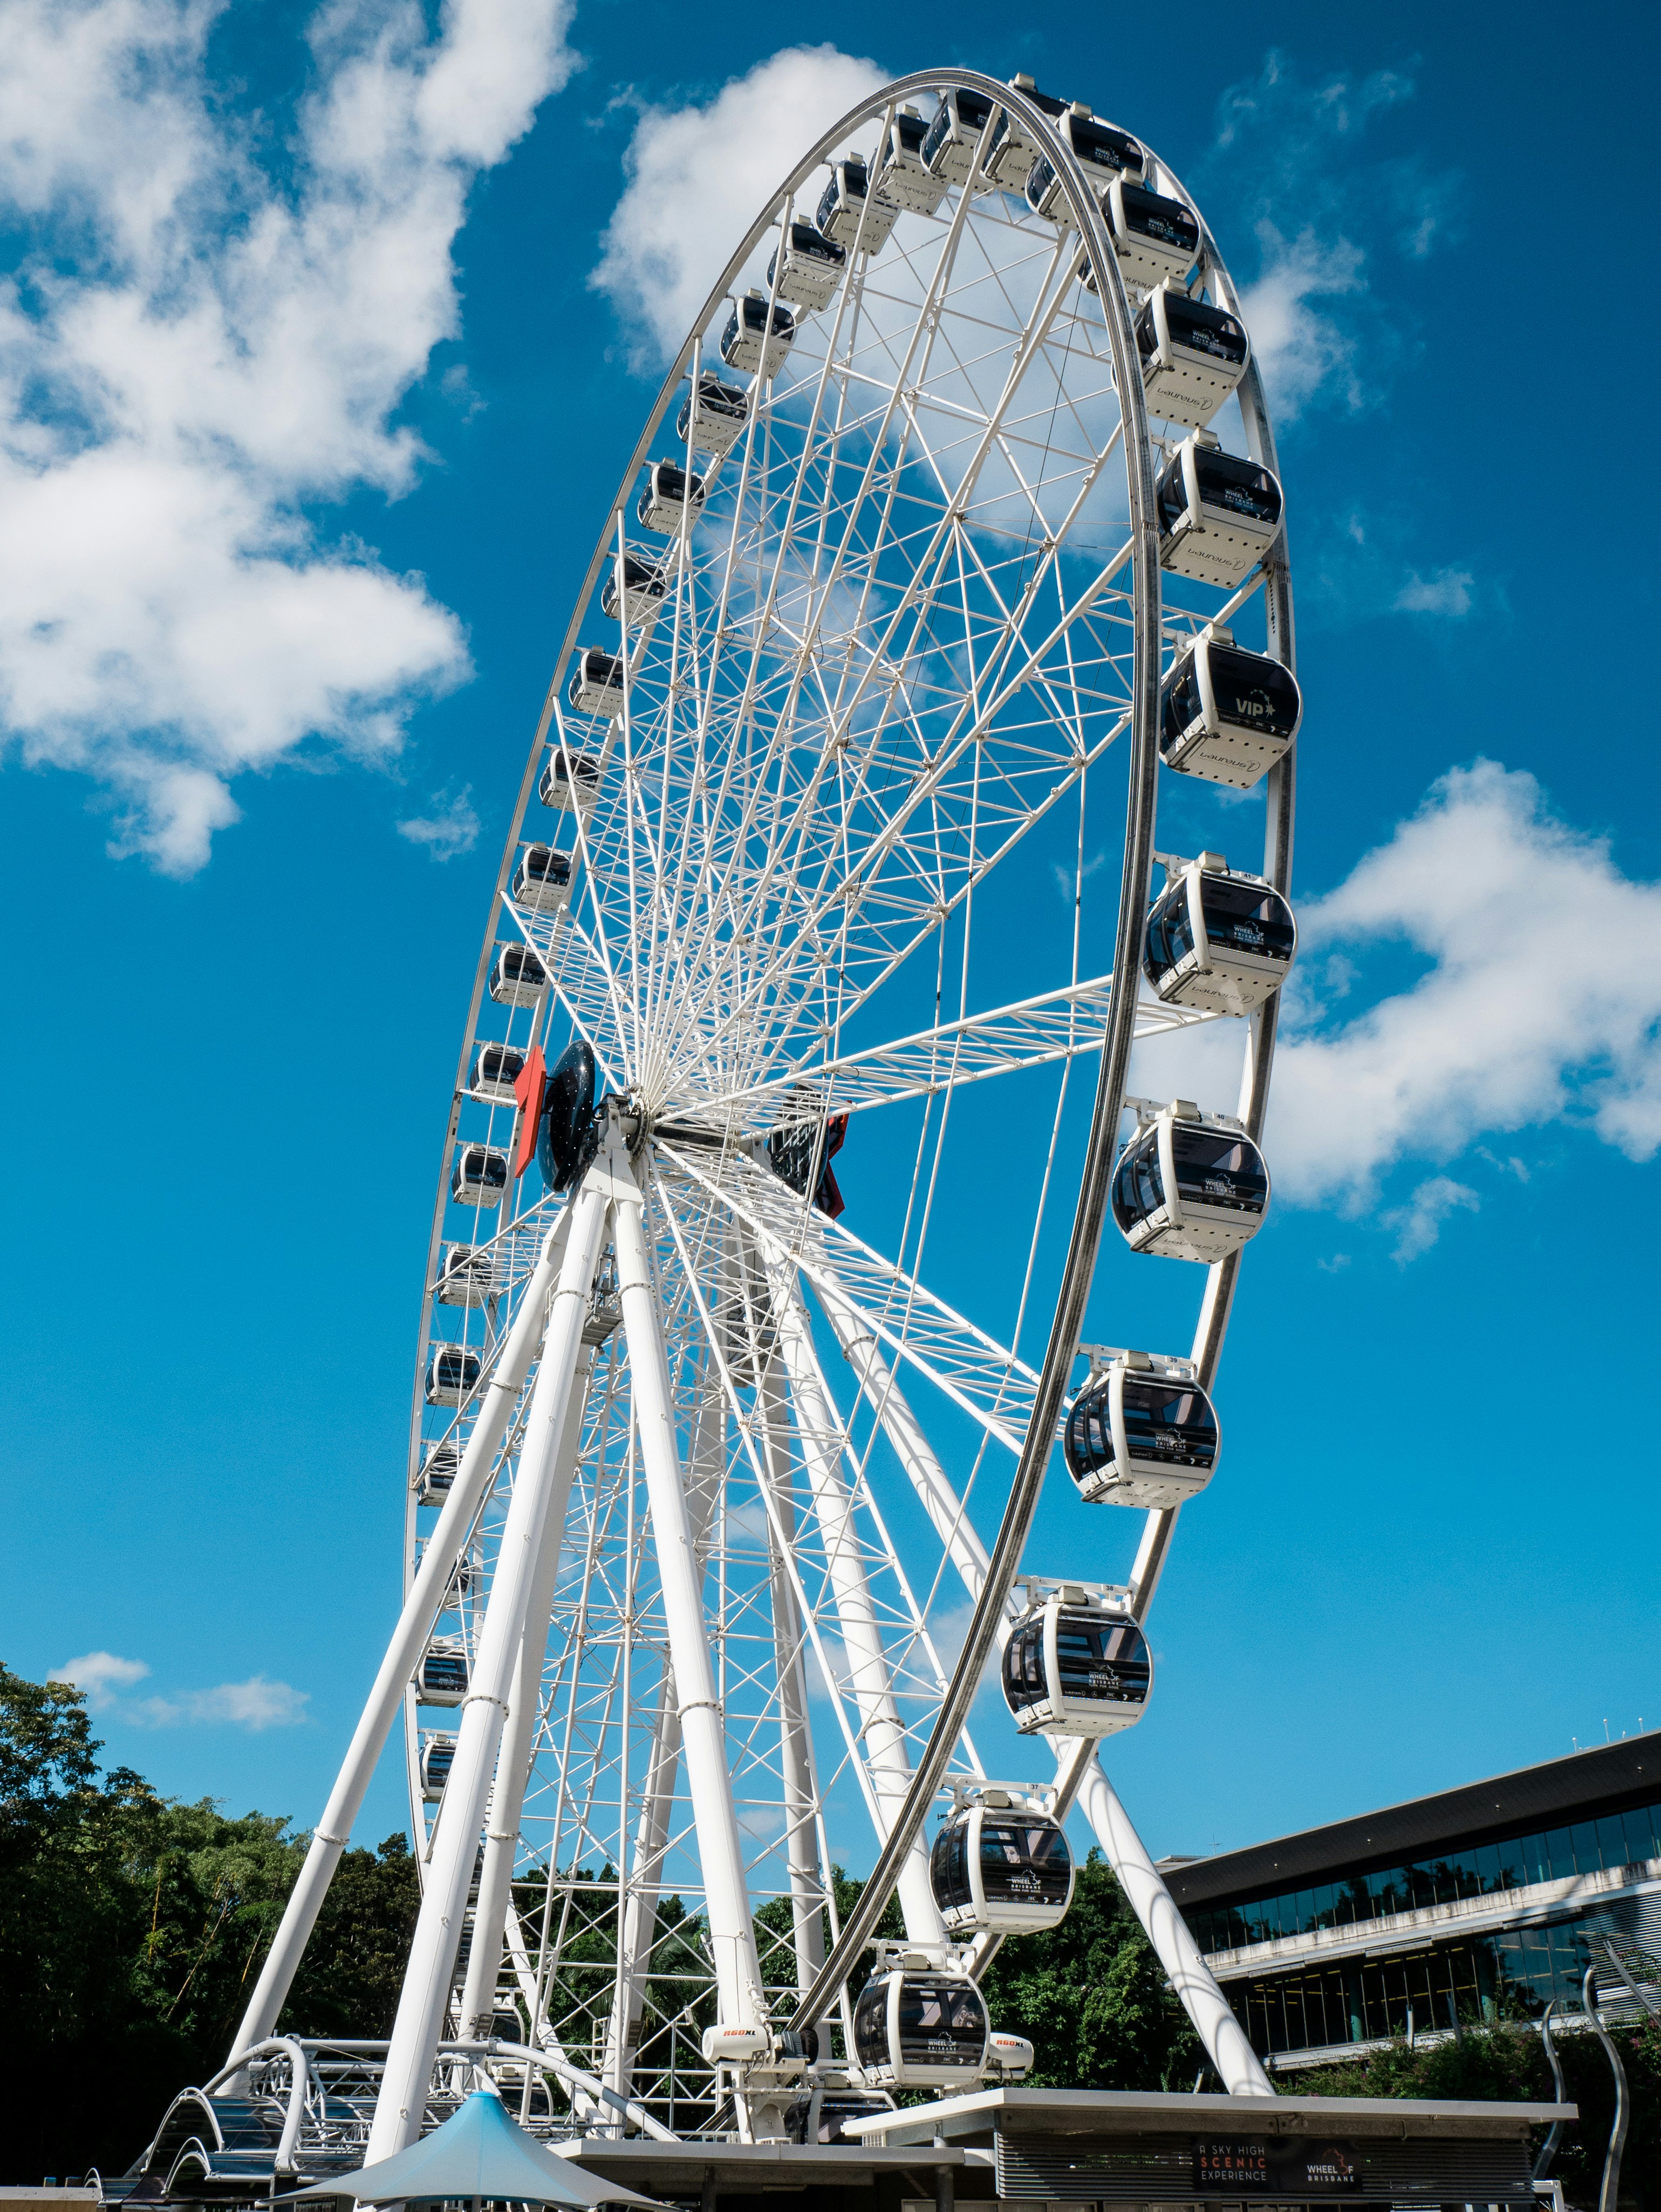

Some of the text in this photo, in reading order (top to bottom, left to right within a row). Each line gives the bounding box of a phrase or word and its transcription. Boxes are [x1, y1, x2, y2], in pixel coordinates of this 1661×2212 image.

[1236, 698, 1263, 716] VIP
[1234, 926, 1254, 935] WHEEL
[996, 2039, 1024, 2048] R60XL
[1200, 2145, 1264, 2155] A SKY HIGH
[1201, 2157, 1266, 2168] SCENIC
[1307, 2165, 1338, 2174] WHEEL
[1201, 2170, 1266, 2180] EXPERIENCE
